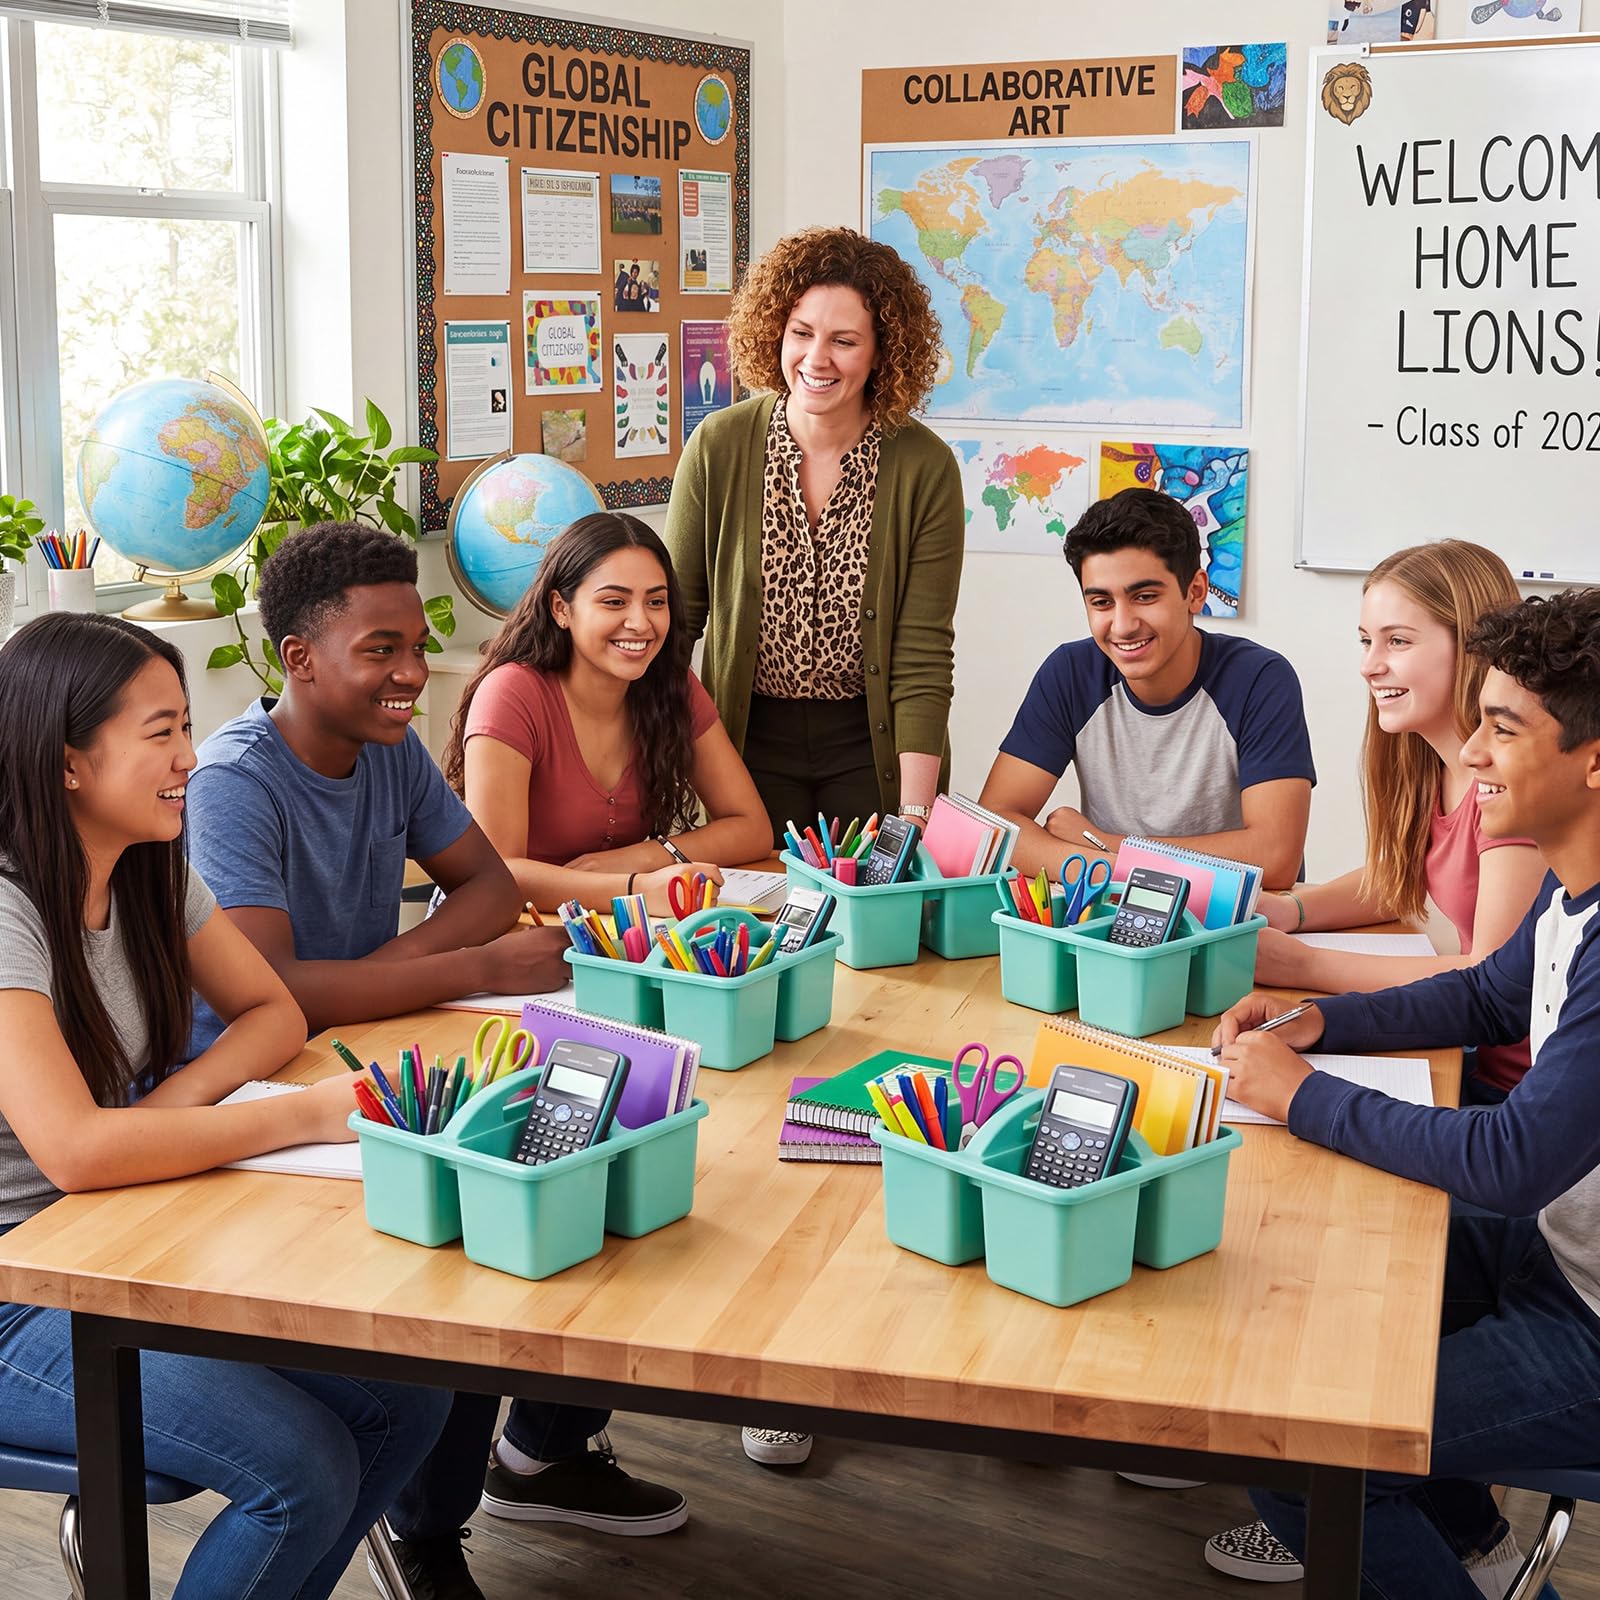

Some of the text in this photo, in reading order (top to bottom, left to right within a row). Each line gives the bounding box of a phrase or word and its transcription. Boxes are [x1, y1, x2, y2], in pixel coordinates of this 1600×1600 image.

[521, 52, 651, 109] GLOBAL
[903, 64, 1157, 105] COLLABORATIVE
[486, 101, 692, 161] CITIZENSHIP
[1008, 104, 1071, 137] ART
[1356, 131, 1600, 207] WELCOM
[1415, 222, 1578, 290] HOME
[541, 342, 585, 357] CITIZENSHIP
[548, 326, 576, 340] GLOBAL
[1396, 405, 1480, 448] Class
[1493, 409, 1528, 449] of
